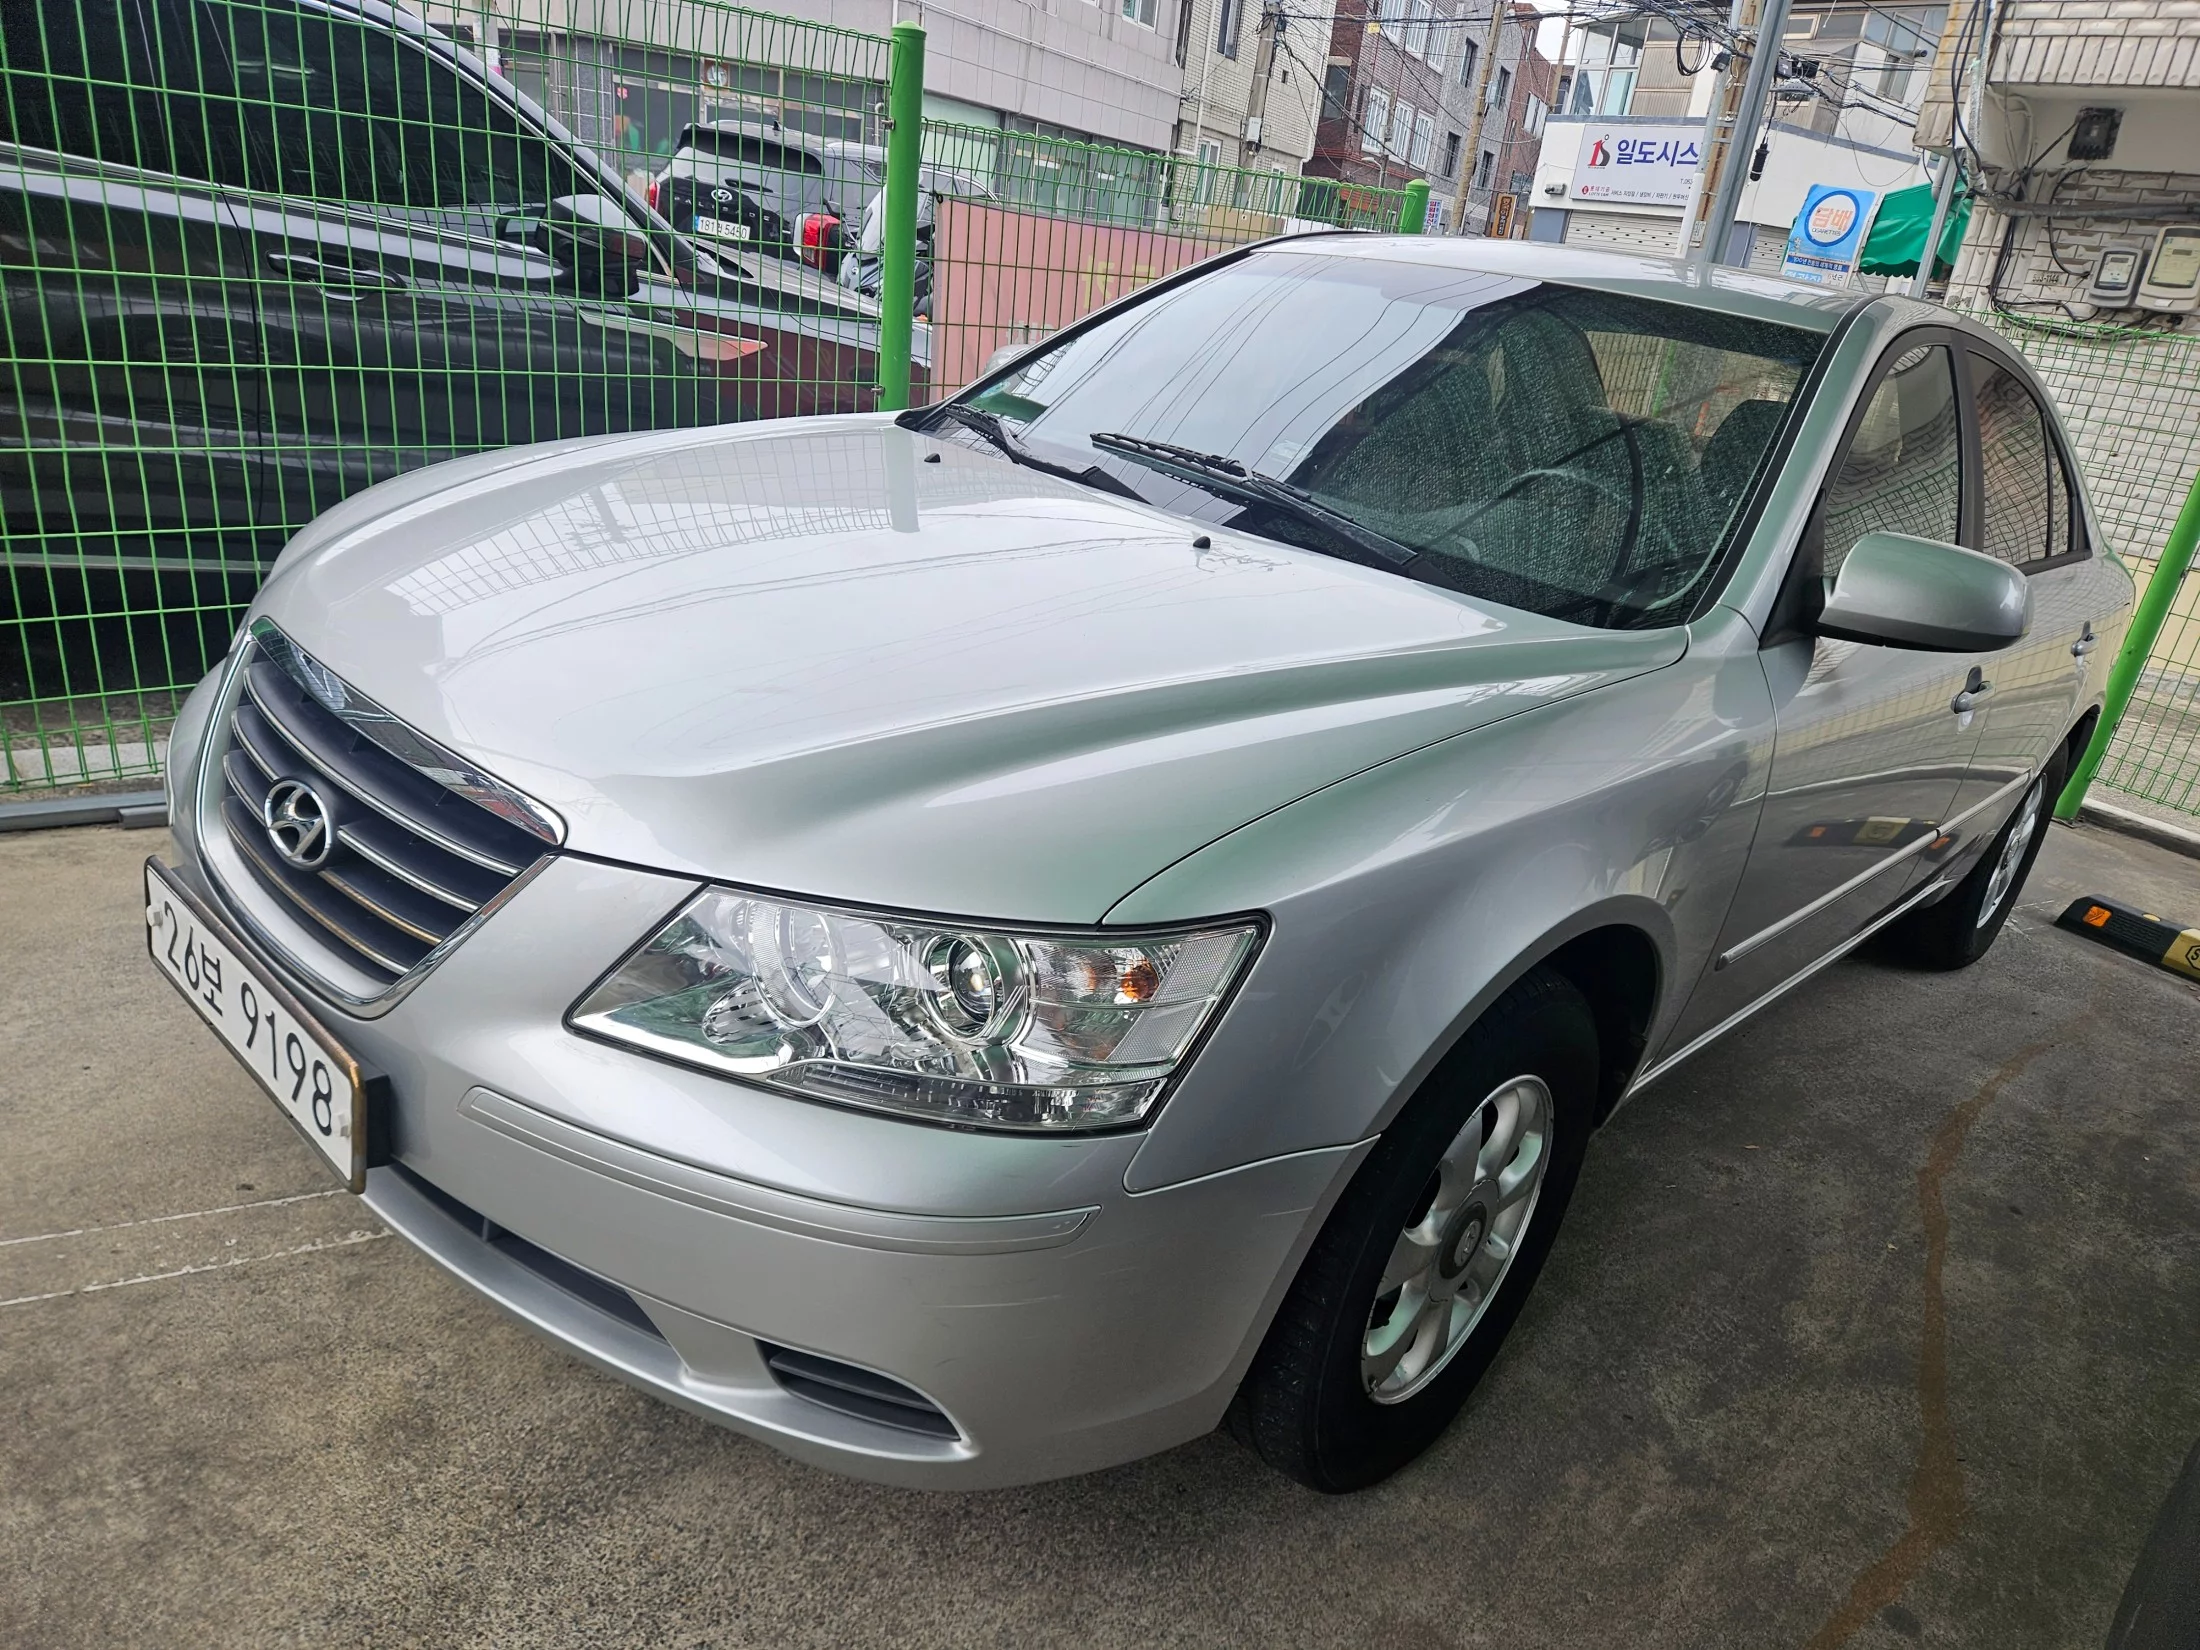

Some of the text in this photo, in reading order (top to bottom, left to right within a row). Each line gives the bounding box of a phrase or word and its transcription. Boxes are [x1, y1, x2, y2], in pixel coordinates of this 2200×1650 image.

[1616, 139, 1699, 167] 일도시스
[1811, 228, 1842, 237] CIGARETTES
[1812, 206, 1854, 232] 담배
[164, 900, 333, 1137] 26보 9198
